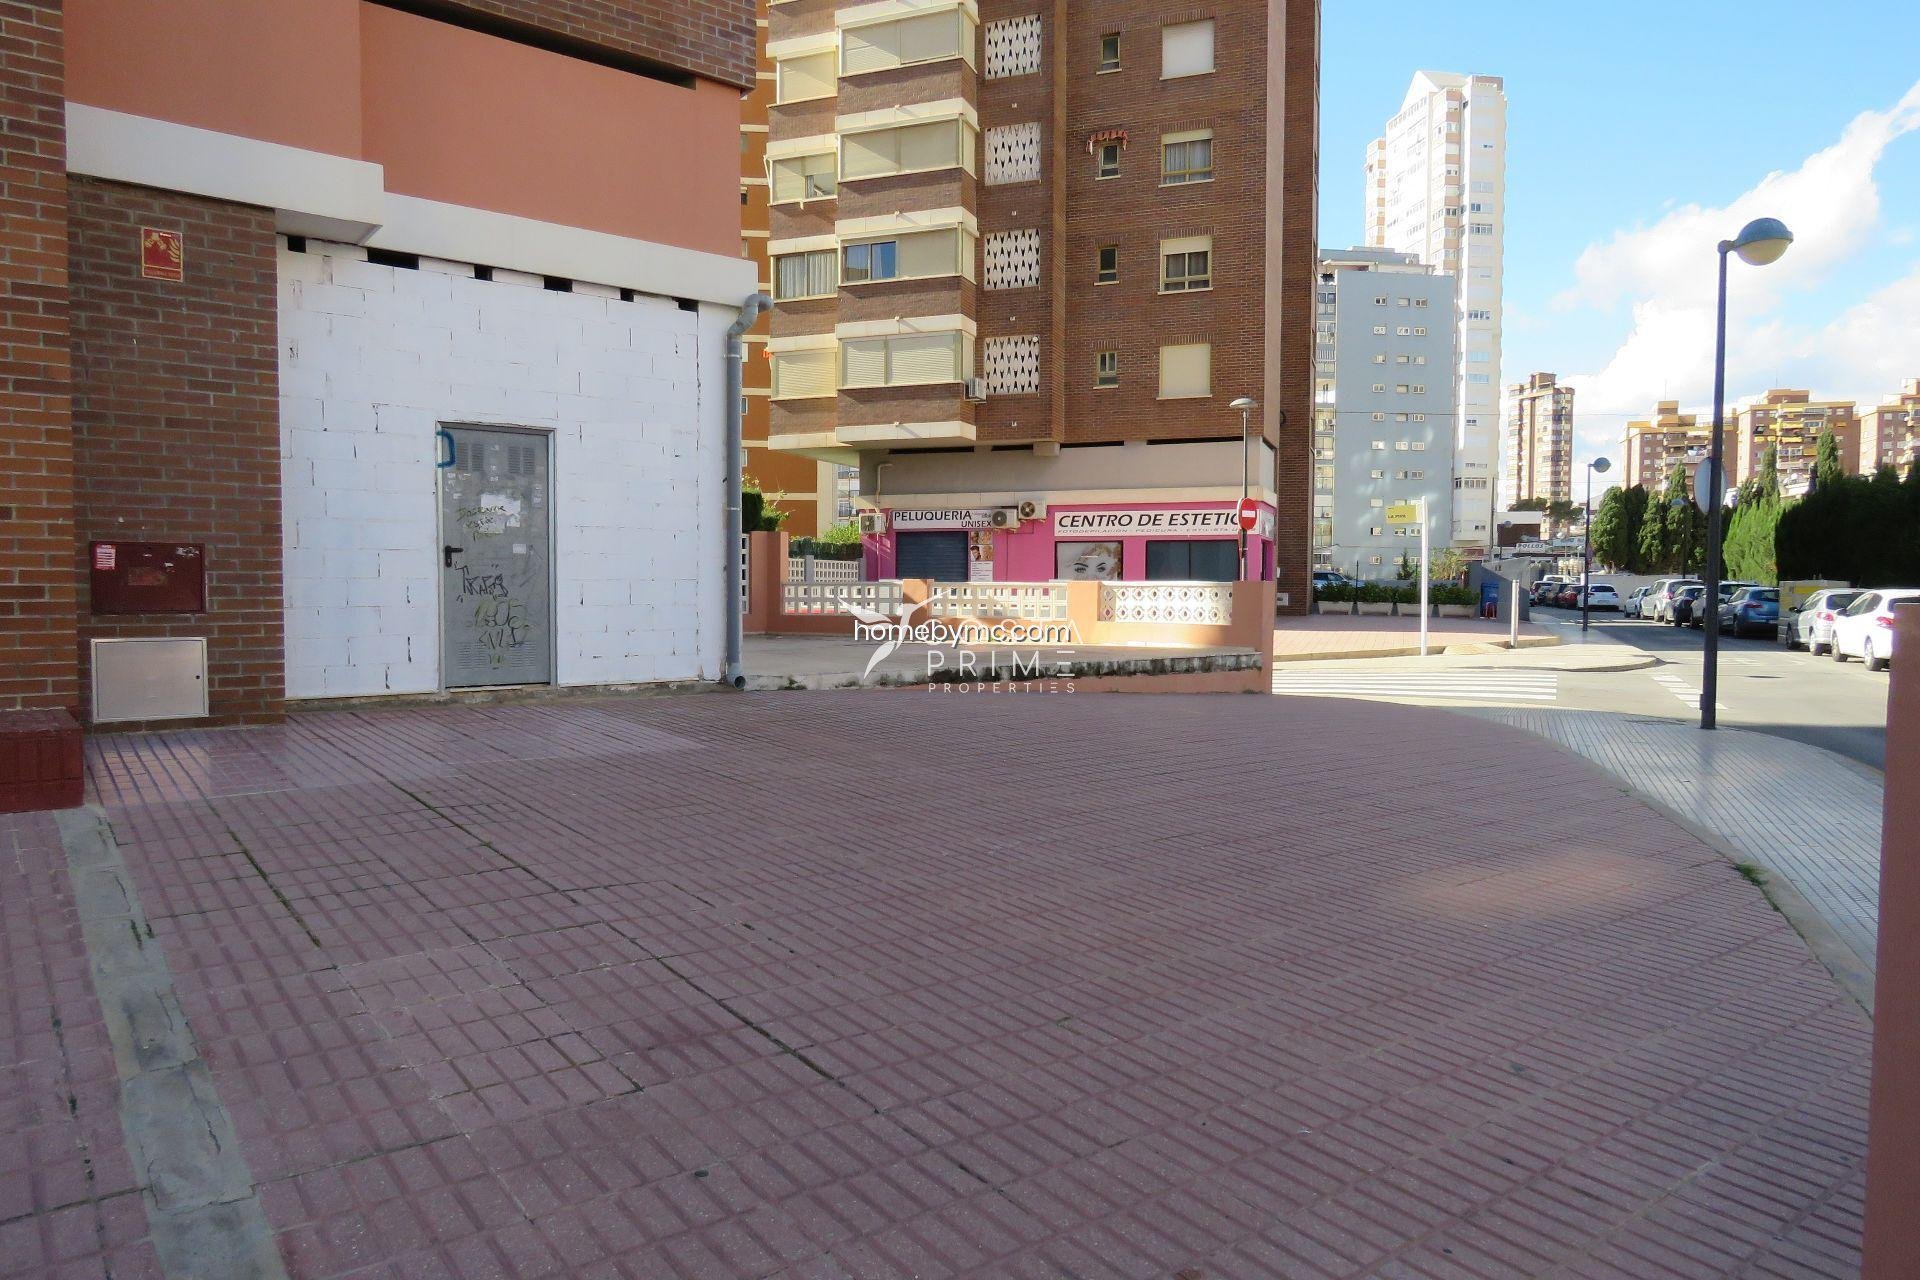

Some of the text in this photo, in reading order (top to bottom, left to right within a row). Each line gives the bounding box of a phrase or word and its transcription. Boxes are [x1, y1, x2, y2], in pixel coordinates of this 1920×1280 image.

[894, 510, 972, 521] PELUQUERIA
[1058, 512, 1239, 527] CENTRO DE ESTETIC
[961, 520, 992, 528] UNISEX
